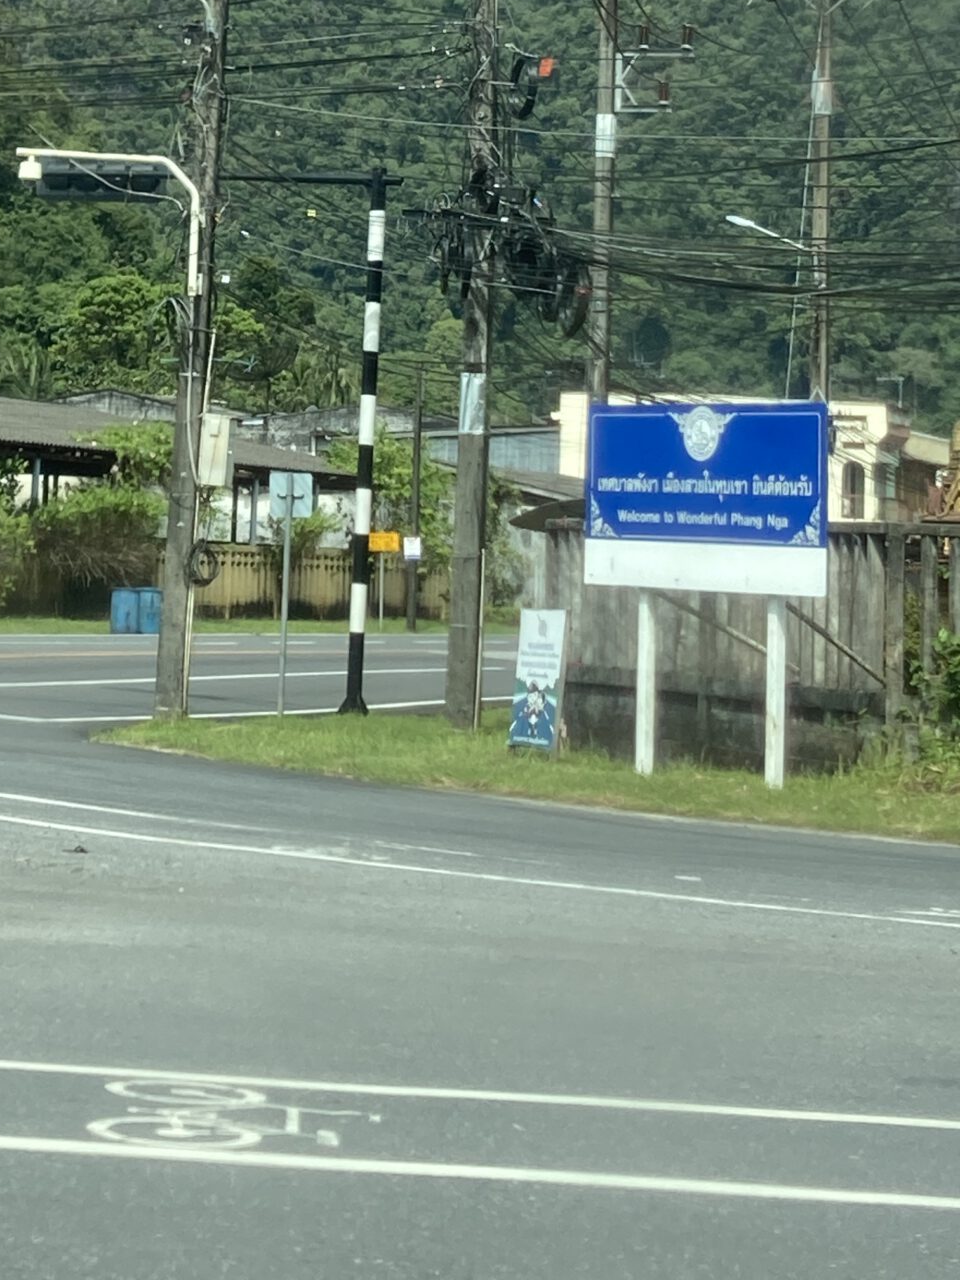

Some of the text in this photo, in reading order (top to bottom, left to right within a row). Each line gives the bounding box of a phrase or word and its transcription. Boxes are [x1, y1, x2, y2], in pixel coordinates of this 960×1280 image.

[617, 509, 789, 531] Welcome to Wonderful Phang Nga
